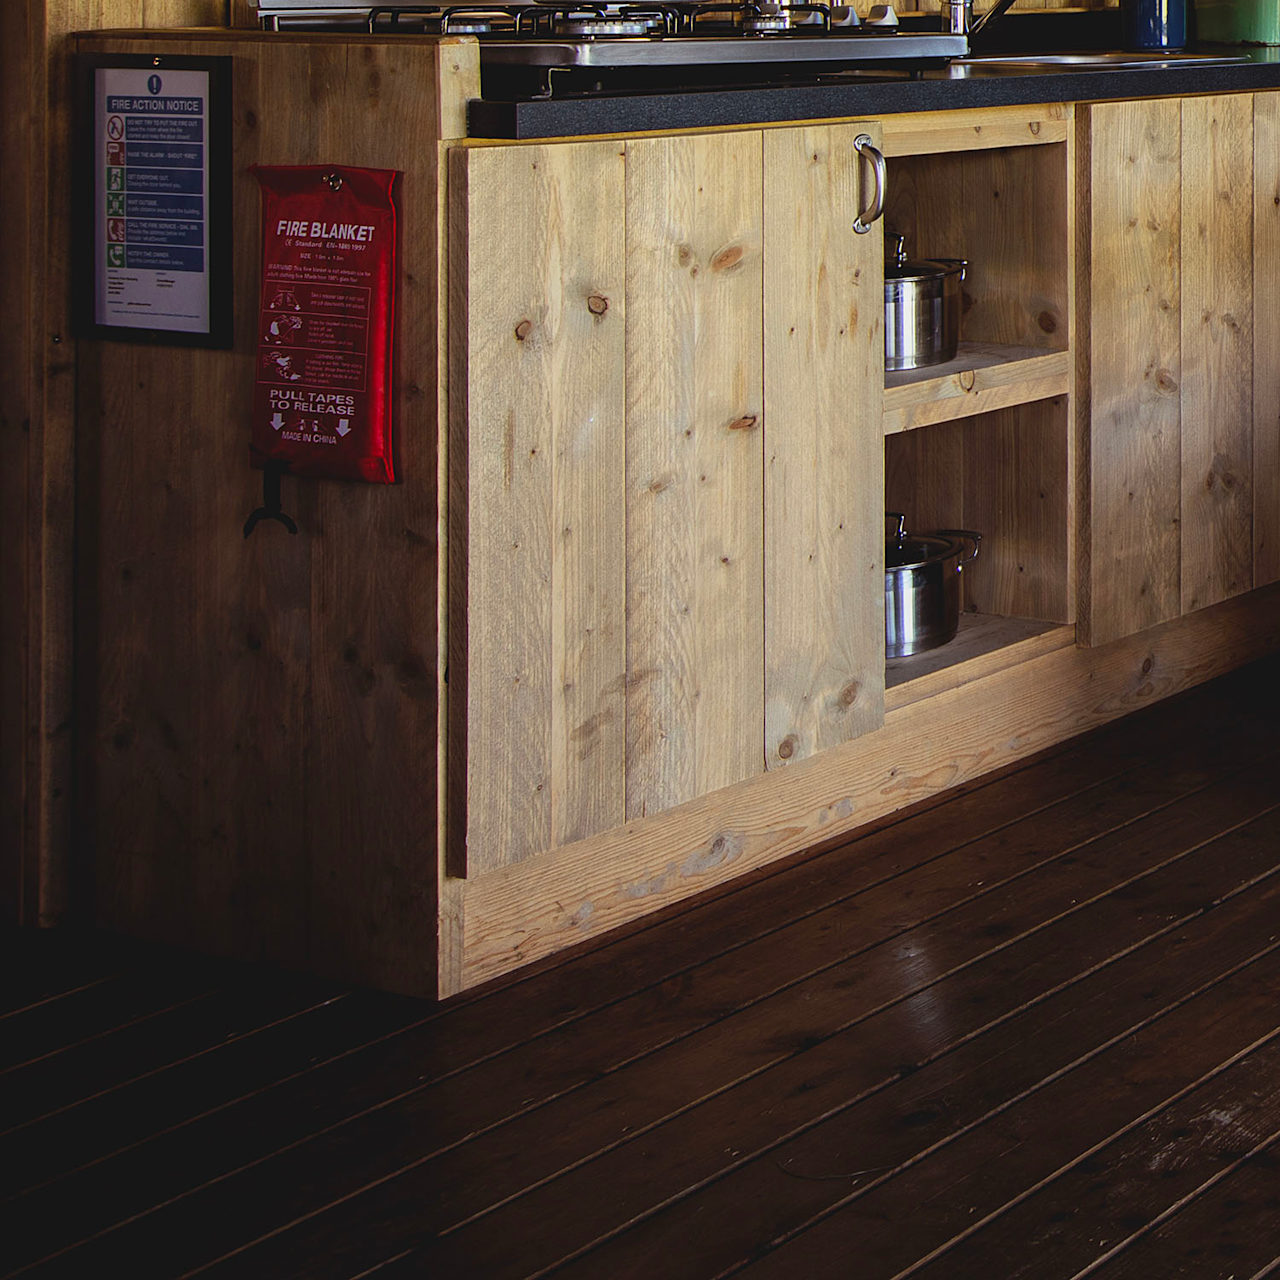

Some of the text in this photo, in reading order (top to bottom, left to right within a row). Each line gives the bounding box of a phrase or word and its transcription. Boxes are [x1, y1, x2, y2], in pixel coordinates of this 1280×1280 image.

[111, 99, 199, 112] FIRE ACTION NOTICE
[276, 220, 375, 242] FIRE BLANKET
[269, 389, 354, 406] PULL TAPES
[269, 399, 355, 416] TO RELEASE
[282, 431, 337, 445] MADE IN CHINA
